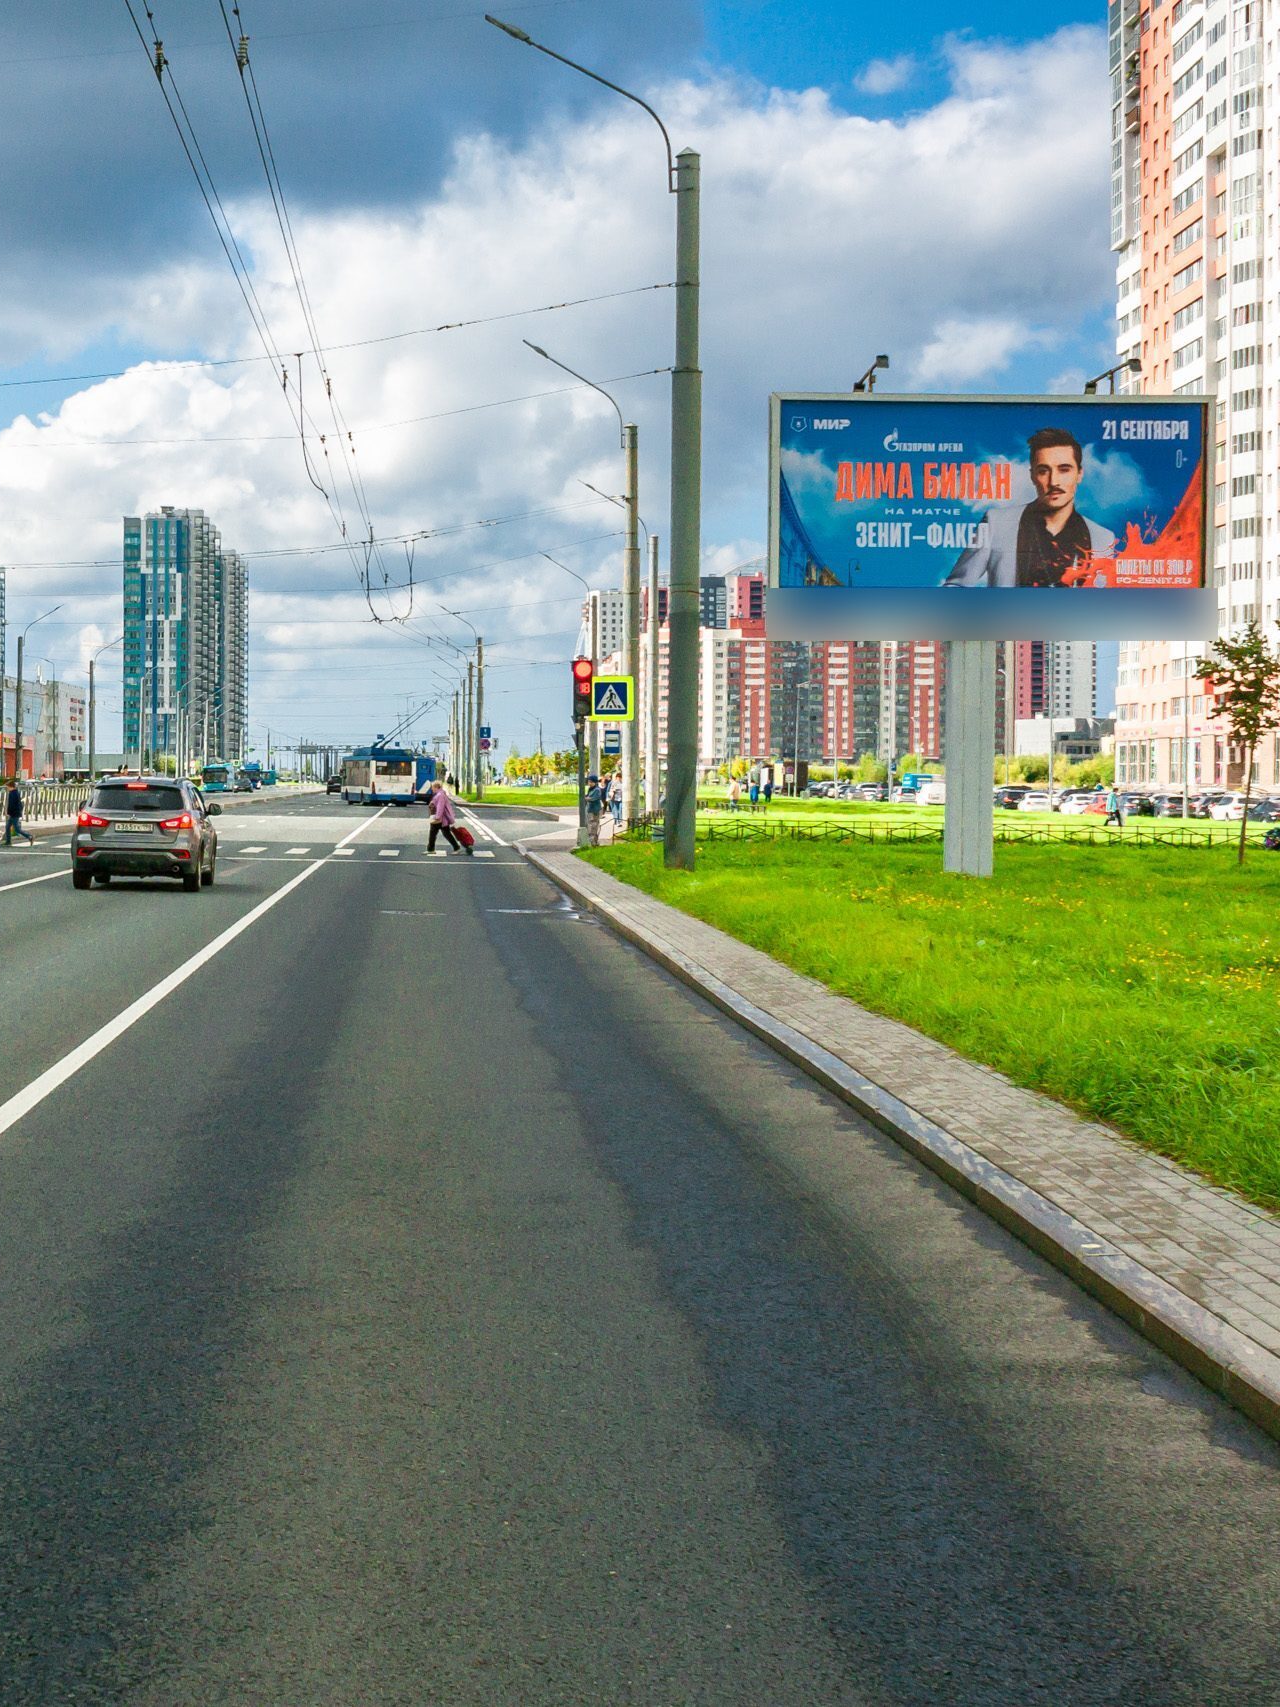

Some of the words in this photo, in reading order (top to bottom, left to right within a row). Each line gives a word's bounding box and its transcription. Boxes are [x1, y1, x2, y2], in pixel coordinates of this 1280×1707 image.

[813, 418, 851, 430] МИР
[1102, 420, 1117, 440] 21
[1120, 420, 1189, 440] СЕНТЯБРЯ
[937, 442, 964, 453] АРЕНА
[835, 462, 914, 502] ДИМА
[923, 462, 1012, 500] БИЛАН
[884, 507, 905, 515] НА
[911, 508, 961, 516] МАТЧЕ
[1116, 577, 1193, 585] FC-ZENIT.RU
